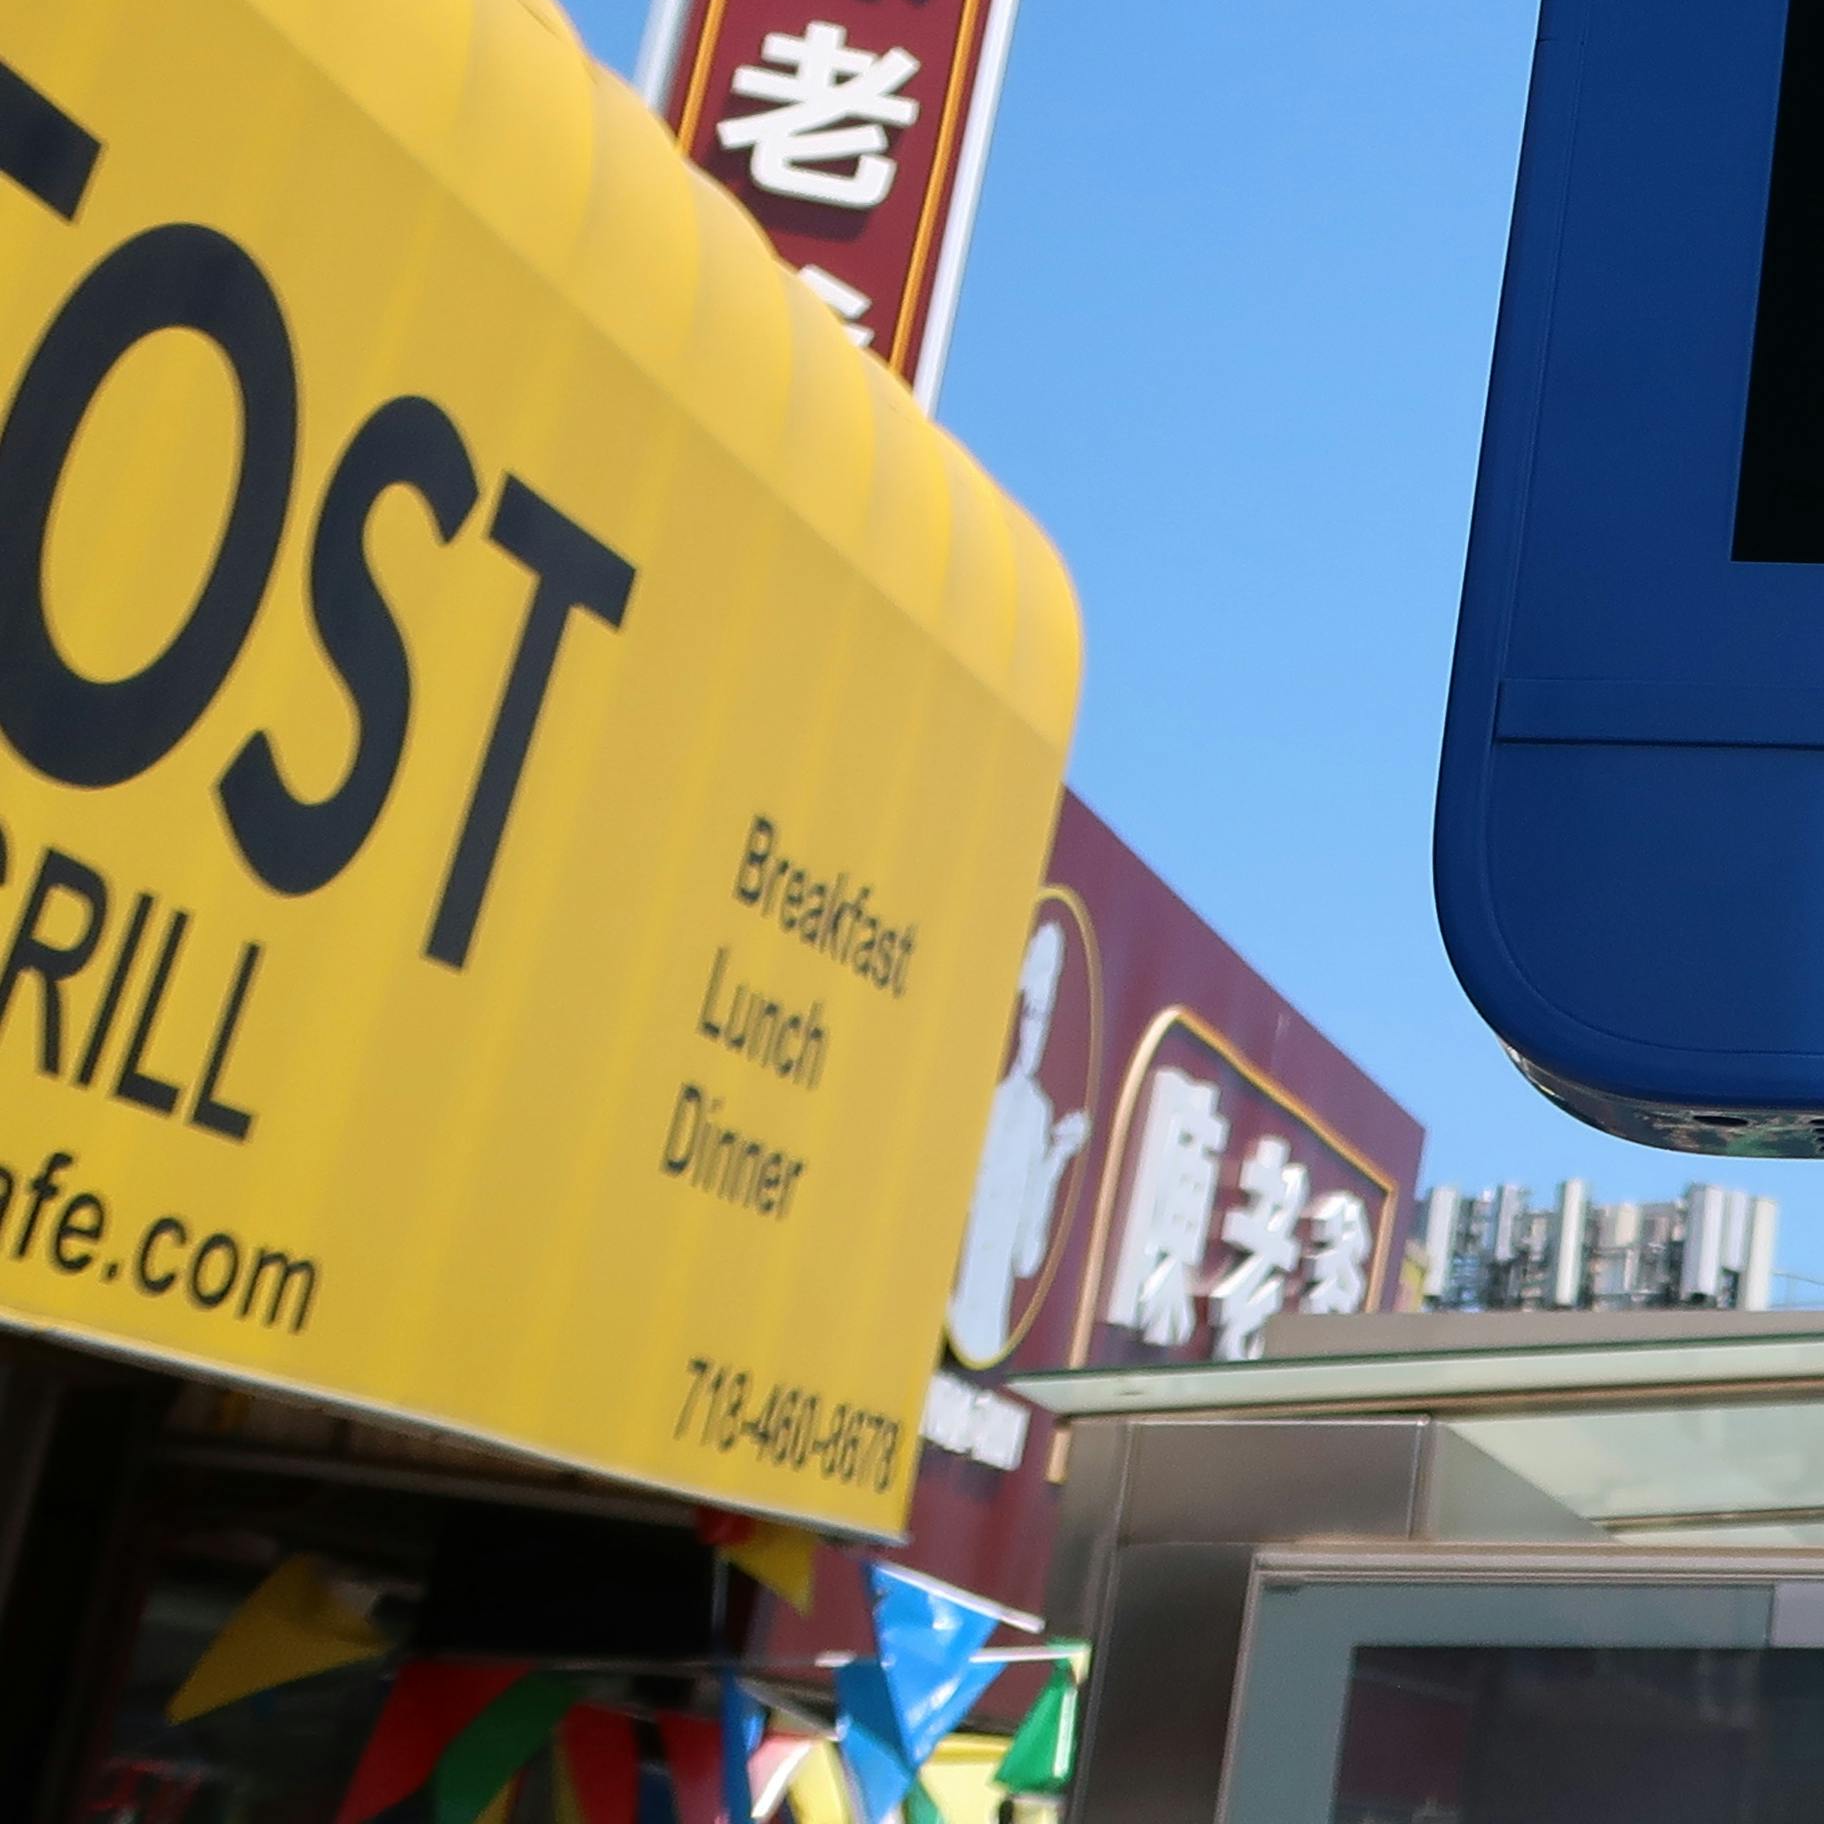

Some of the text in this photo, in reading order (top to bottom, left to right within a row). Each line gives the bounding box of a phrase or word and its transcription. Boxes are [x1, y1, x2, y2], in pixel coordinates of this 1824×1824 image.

[0, 60, 636, 970] OST
[0, 818, 258, 1142] RILL
[733, 814, 919, 999] Breakfast
[699, 944, 828, 1092] Lunch
[663, 1081, 805, 1221] Dinner
